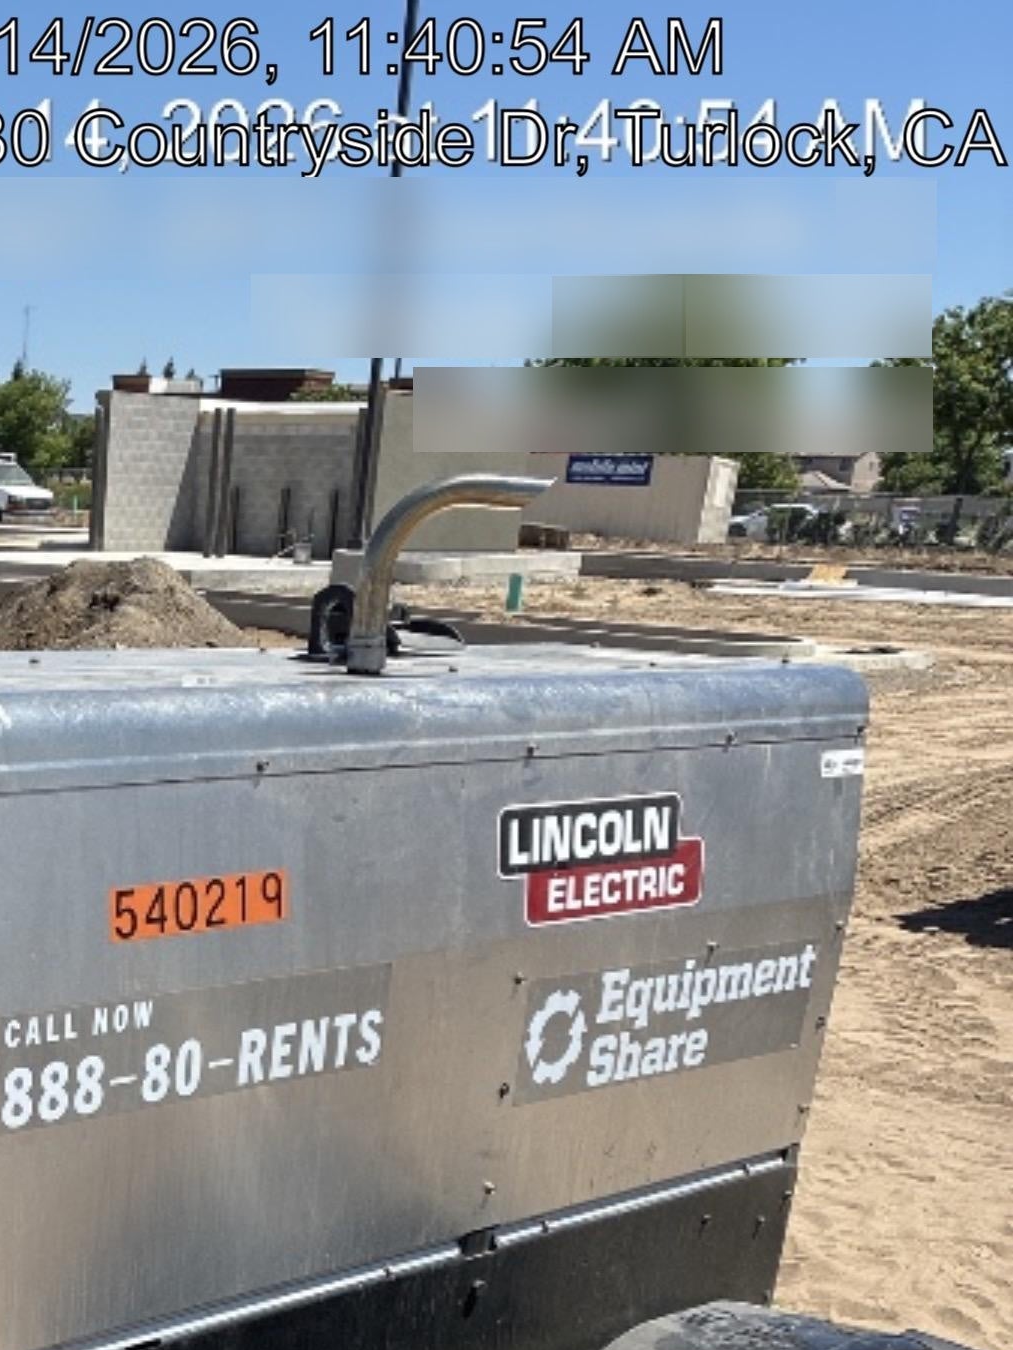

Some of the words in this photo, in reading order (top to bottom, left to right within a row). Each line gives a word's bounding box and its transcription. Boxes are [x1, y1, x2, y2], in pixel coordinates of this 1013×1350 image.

[508, 806, 672, 866] LINCOLN
[114, 872, 282, 939] 540219
[547, 863, 685, 913] ELECTRIC
[595, 944, 817, 1028] Equipment
[4, 1012, 78, 1048] CALL
[92, 1001, 154, 1036] NOW
[1, 1009, 383, 1129] 888-80-RENTS
[587, 1027, 708, 1087] Share
